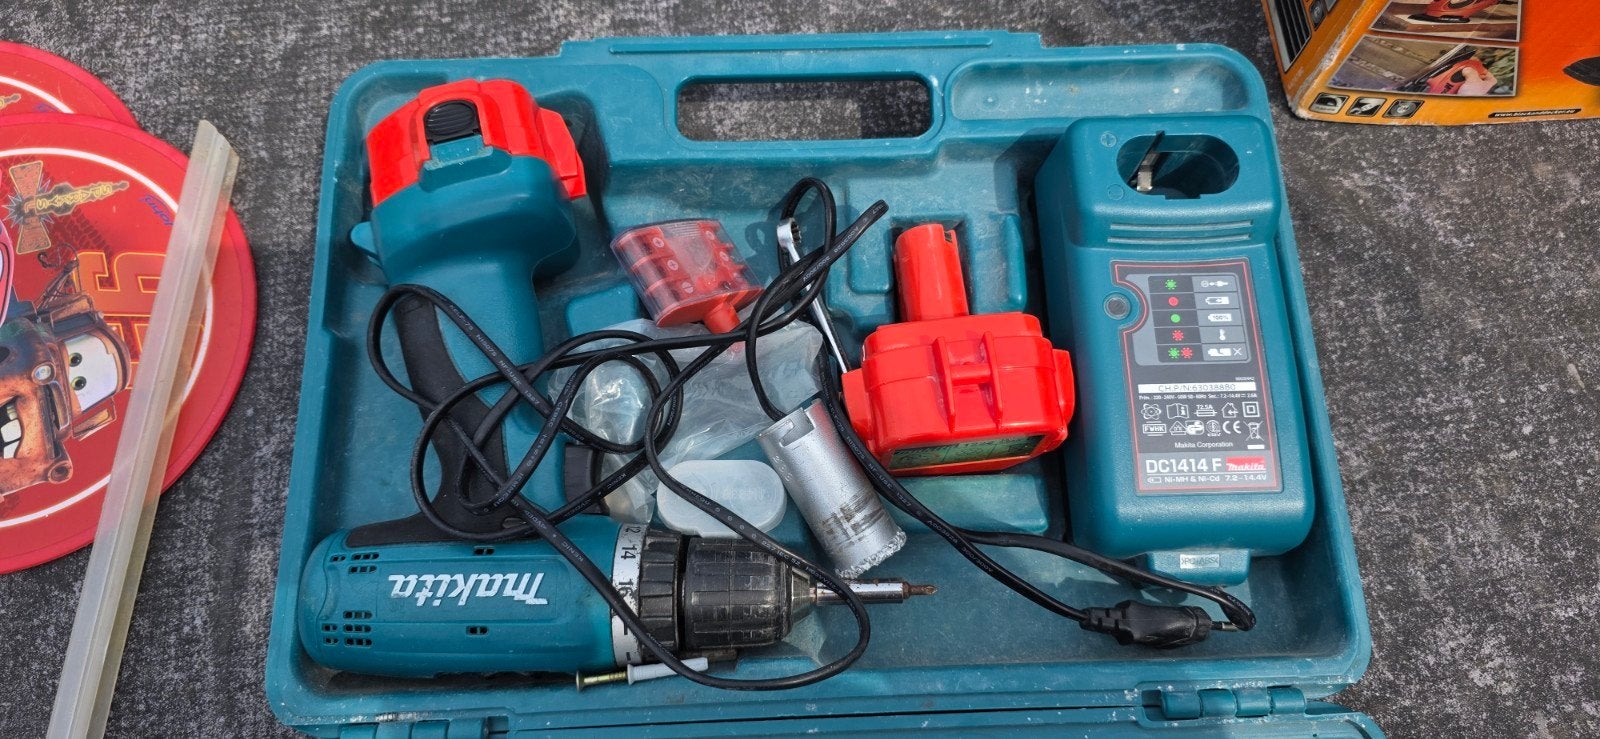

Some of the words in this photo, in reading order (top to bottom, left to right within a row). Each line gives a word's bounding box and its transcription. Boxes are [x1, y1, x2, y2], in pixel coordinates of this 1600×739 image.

[1174, 441, 1196, 449] Makita
[1197, 441, 1233, 449] Corporation
[1164, 476, 1189, 484] Ni-MH
[1198, 475, 1220, 483] Ni-Cd
[621, 546, 638, 560] 14
